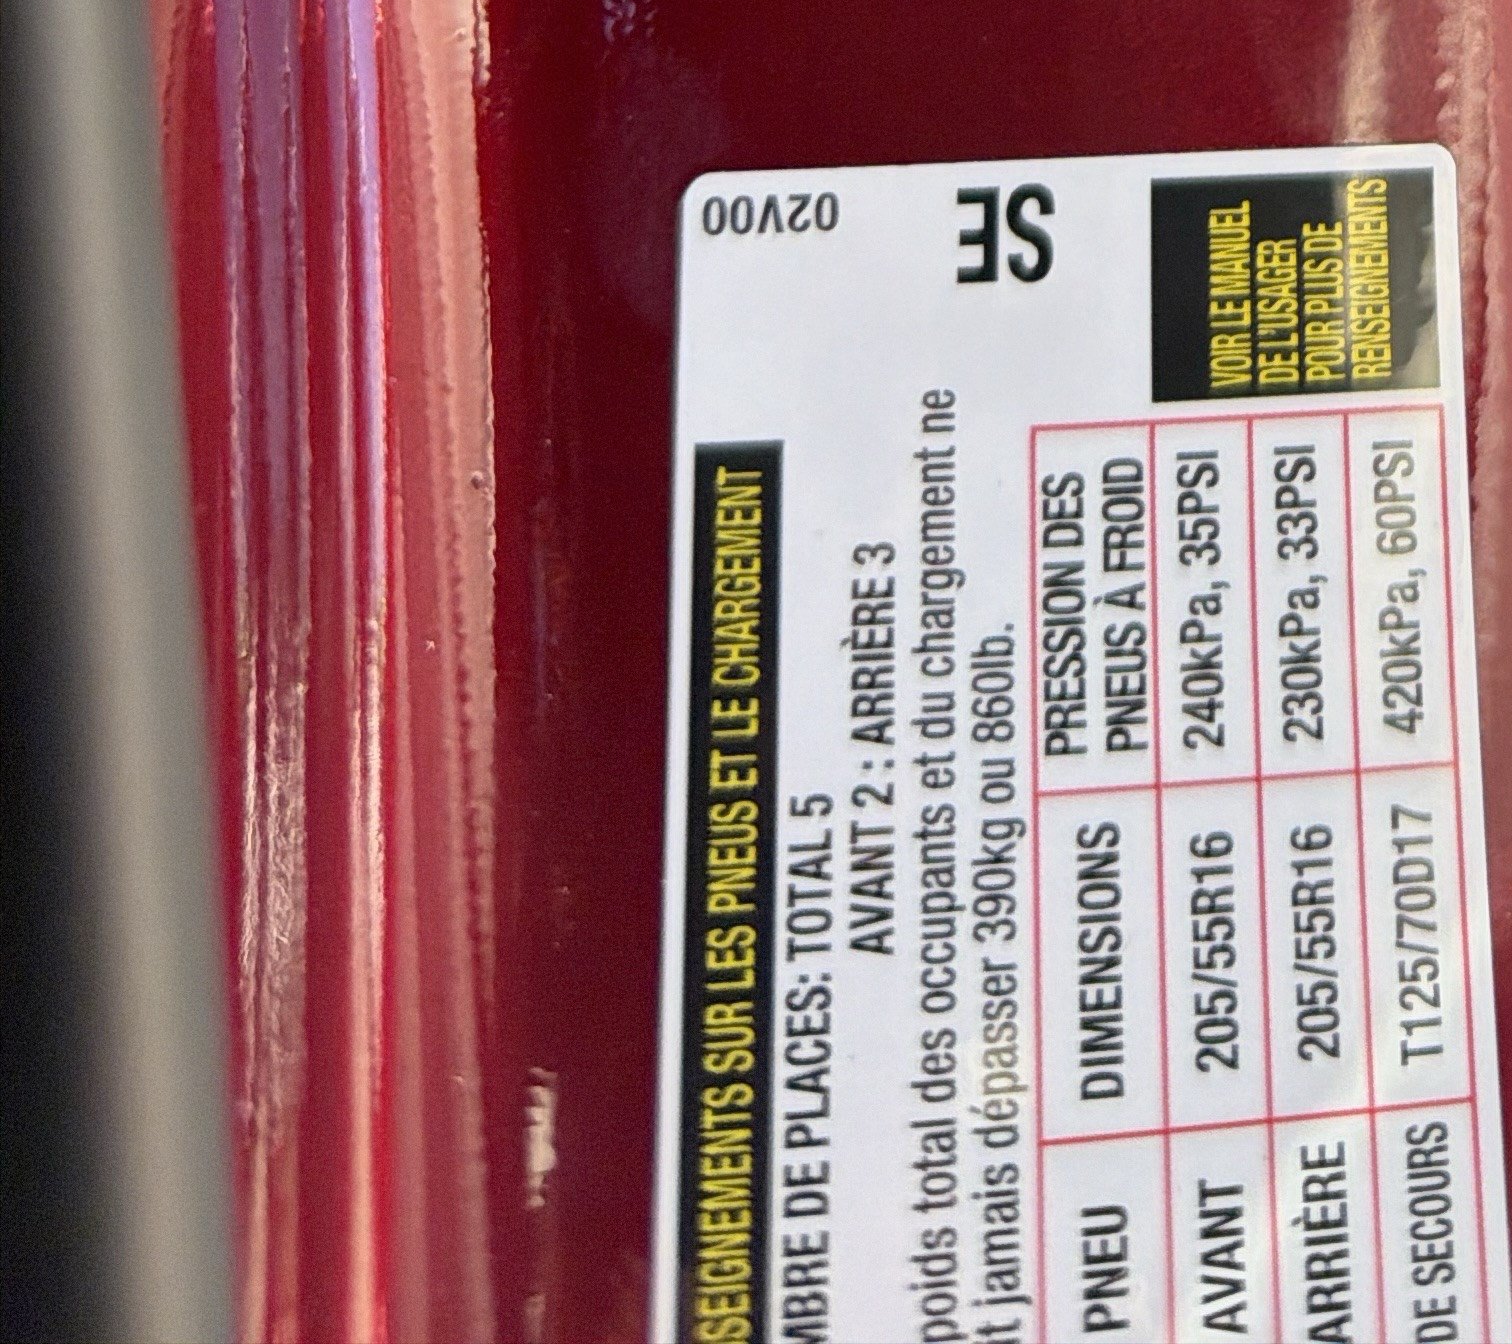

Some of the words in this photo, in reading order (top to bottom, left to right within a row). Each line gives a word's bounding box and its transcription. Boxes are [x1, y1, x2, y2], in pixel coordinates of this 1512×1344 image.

[702, 192, 840, 235] 02V00
[956, 183, 1055, 283] SE
[1208, 200, 1251, 296] MANUEL
[1303, 221, 1343, 252] DE
[1209, 300, 1251, 327] LE
[1256, 239, 1299, 347] L'USAGER
[1303, 258, 1344, 314] PLUS
[1347, 179, 1391, 378] RENSEIGNEMENTS
[1209, 333, 1252, 387] VOIR
[1258, 352, 1299, 383] DE
[1305, 320, 1346, 381] POUR
[920, 390, 956, 432] ne
[853, 542, 895, 566] 3
[1041, 473, 1085, 548] DES
[1102, 458, 1145, 572] FROID
[1176, 449, 1219, 566] 35PSI
[1273, 445, 1318, 560] 33PSI
[1372, 440, 1418, 555] 60PSI
[712, 467, 764, 686] CHARGEMENT
[913, 447, 965, 678] chargement
[1094, 583, 1146, 611] À
[840, 578, 895, 744] ARRIÈRE
[971, 623, 1015, 743] 860lb.
[1043, 561, 1087, 756] PRESSION
[1103, 622, 1147, 751] PNEUS
[1180, 581, 1230, 748] 240kPa,
[1279, 575, 1328, 742] 230kPa,
[1378, 568, 1427, 734] 420kPa,
[709, 751, 758, 789] ET
[711, 699, 760, 739] LE
[911, 691, 955, 739] du
[914, 751, 956, 789] et
[788, 793, 833, 819] 5
[851, 783, 895, 809] 2
[980, 759, 1016, 803] ou
[706, 801, 758, 913] PNEUS
[786, 829, 832, 961] TOTAL
[850, 822, 895, 955] AVANT
[912, 804, 965, 1013] occupants
[971, 818, 1026, 942] 390kg
[704, 927, 757, 989] LES
[1076, 821, 1124, 1100] DIMENSIONS
[1190, 831, 1240, 1073] 205/55R16
[1290, 824, 1341, 1062] 205/55R16
[1391, 803, 1443, 1066] T125/70D17
[700, 1002, 755, 1073] SUR
[783, 974, 831, 1149] PLACES:
[911, 1028, 957, 1103] des
[970, 957, 1027, 1149] dépasser
[693, 1084, 754, 1344] SEIGNEMENTS
[782, 1161, 829, 1217] DE
[909, 1118, 957, 1213] total
[1405, 1122, 1456, 1284] SECOURS
[906, 1227, 967, 1342] poids
[971, 1163, 1032, 1307] jamais
[1080, 1205, 1129, 1333] PNEU
[1198, 1180, 1247, 1334] AVANT
[1291, 1142, 1352, 1344] ARRIÈRE
[1413, 1297, 1457, 1343] DE
